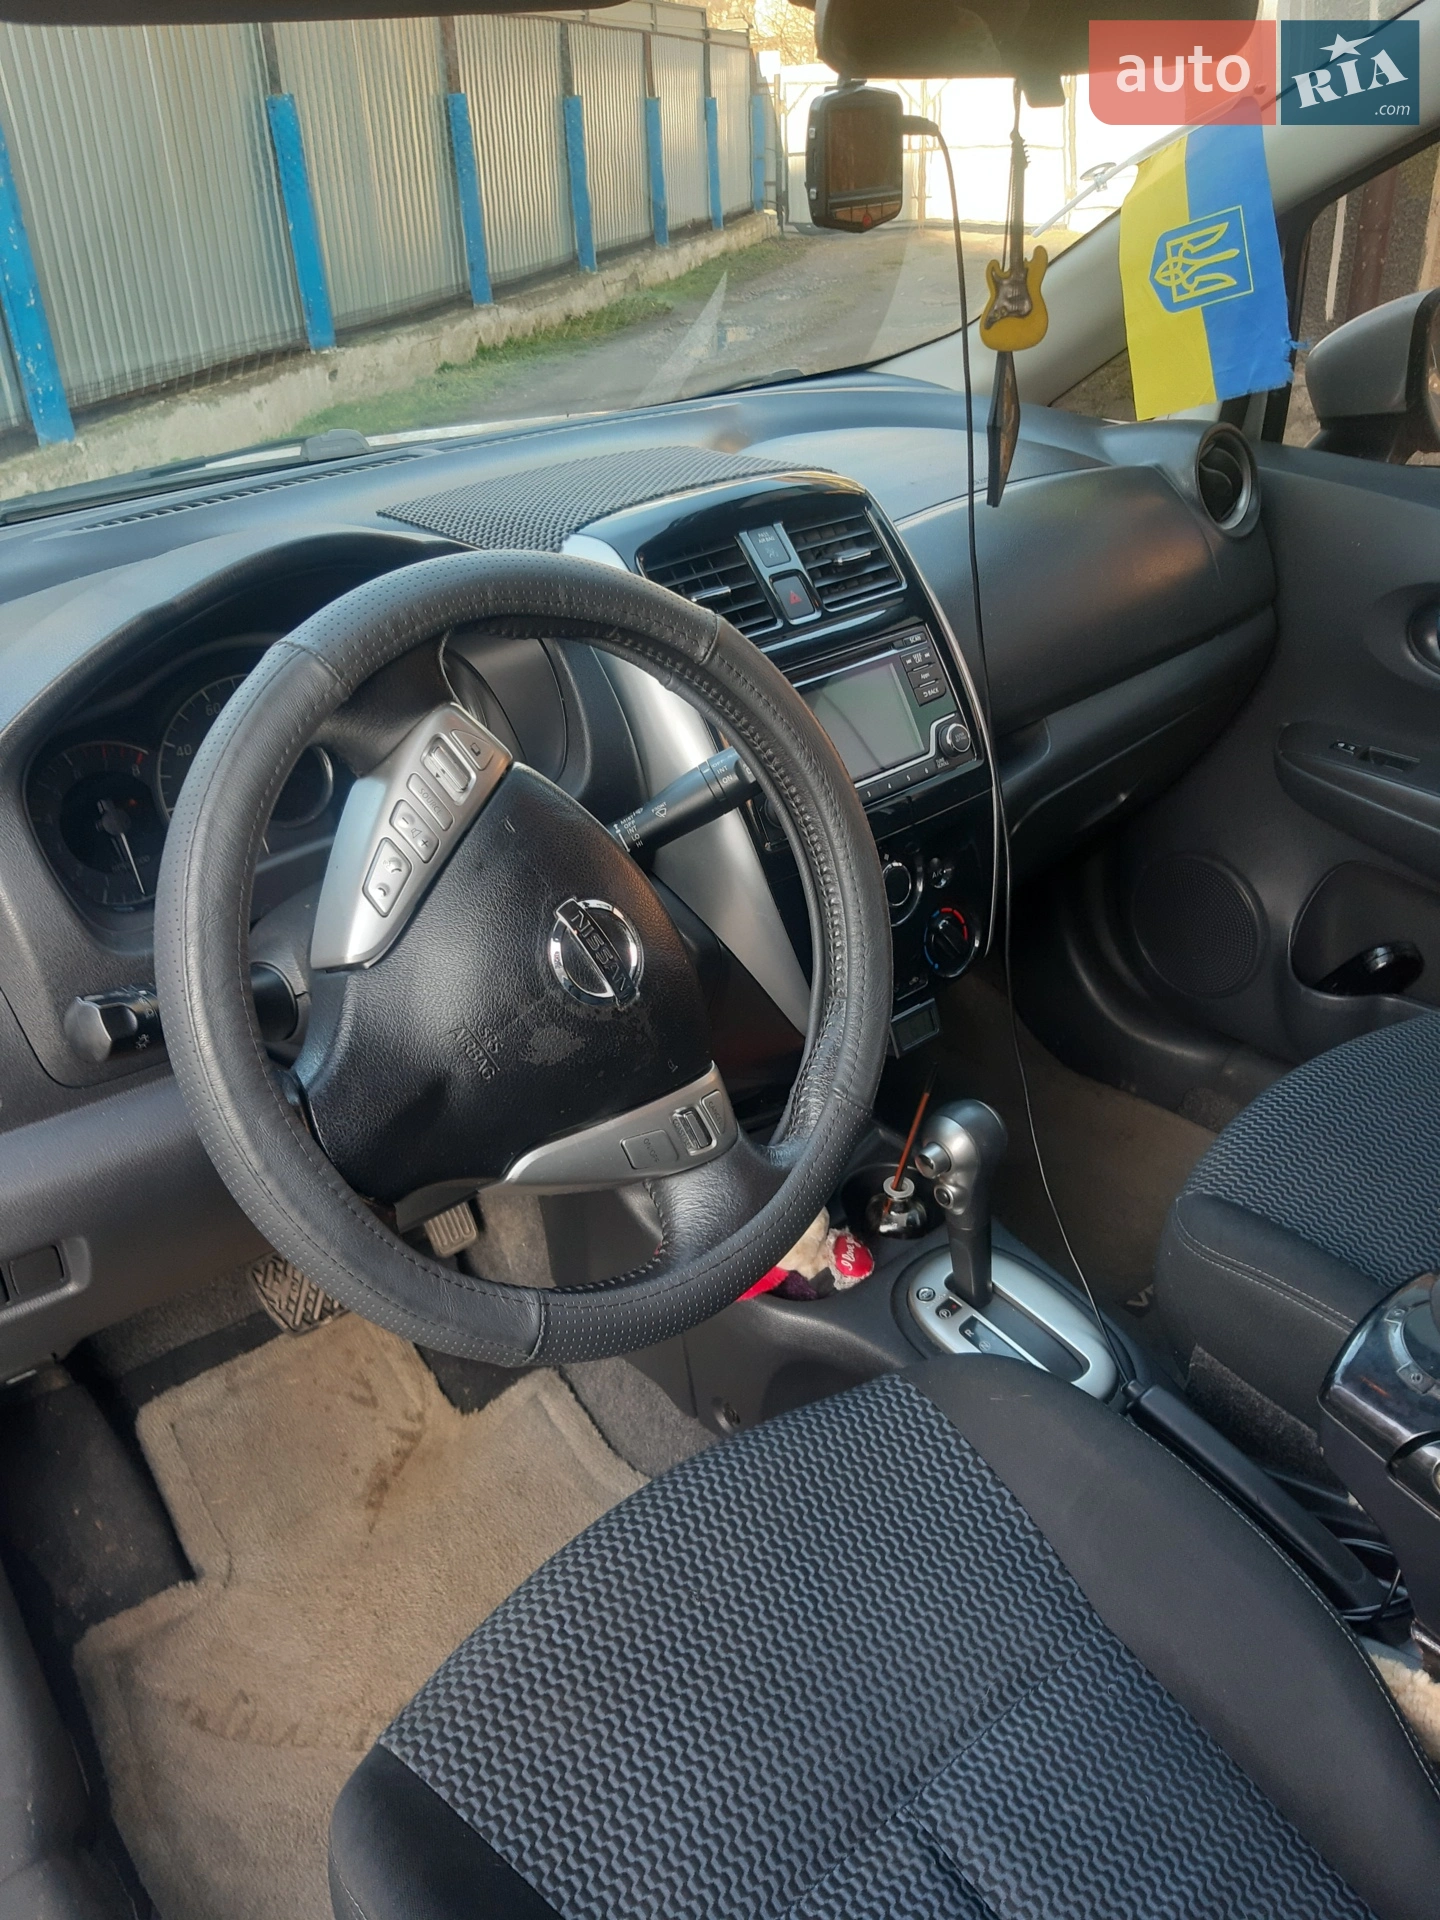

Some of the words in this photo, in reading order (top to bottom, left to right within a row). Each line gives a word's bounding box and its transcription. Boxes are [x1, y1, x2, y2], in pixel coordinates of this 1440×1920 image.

[909, 635, 922, 643] SCAN
[927, 687, 939, 696] BACK
[205, 702, 221, 717] 60
[176, 743, 193, 757] 40
[132, 764, 141, 776] 8
[717, 765, 728, 775] INT
[722, 774, 733, 784] ON
[418, 787, 443, 816] SOURCE
[623, 820, 636, 829] OFF
[626, 825, 638, 835] INT
[631, 833, 641, 841] LO
[635, 840, 644, 848] HI
[571, 910, 631, 999] NISSAN
[478, 1026, 504, 1054] SRS
[450, 1027, 496, 1082] AIRBAG
[708, 1101, 723, 1127] CANCEL
[841, 1244, 856, 1262] love
[841, 1259, 853, 1271] I
[964, 1329, 975, 1338] R
